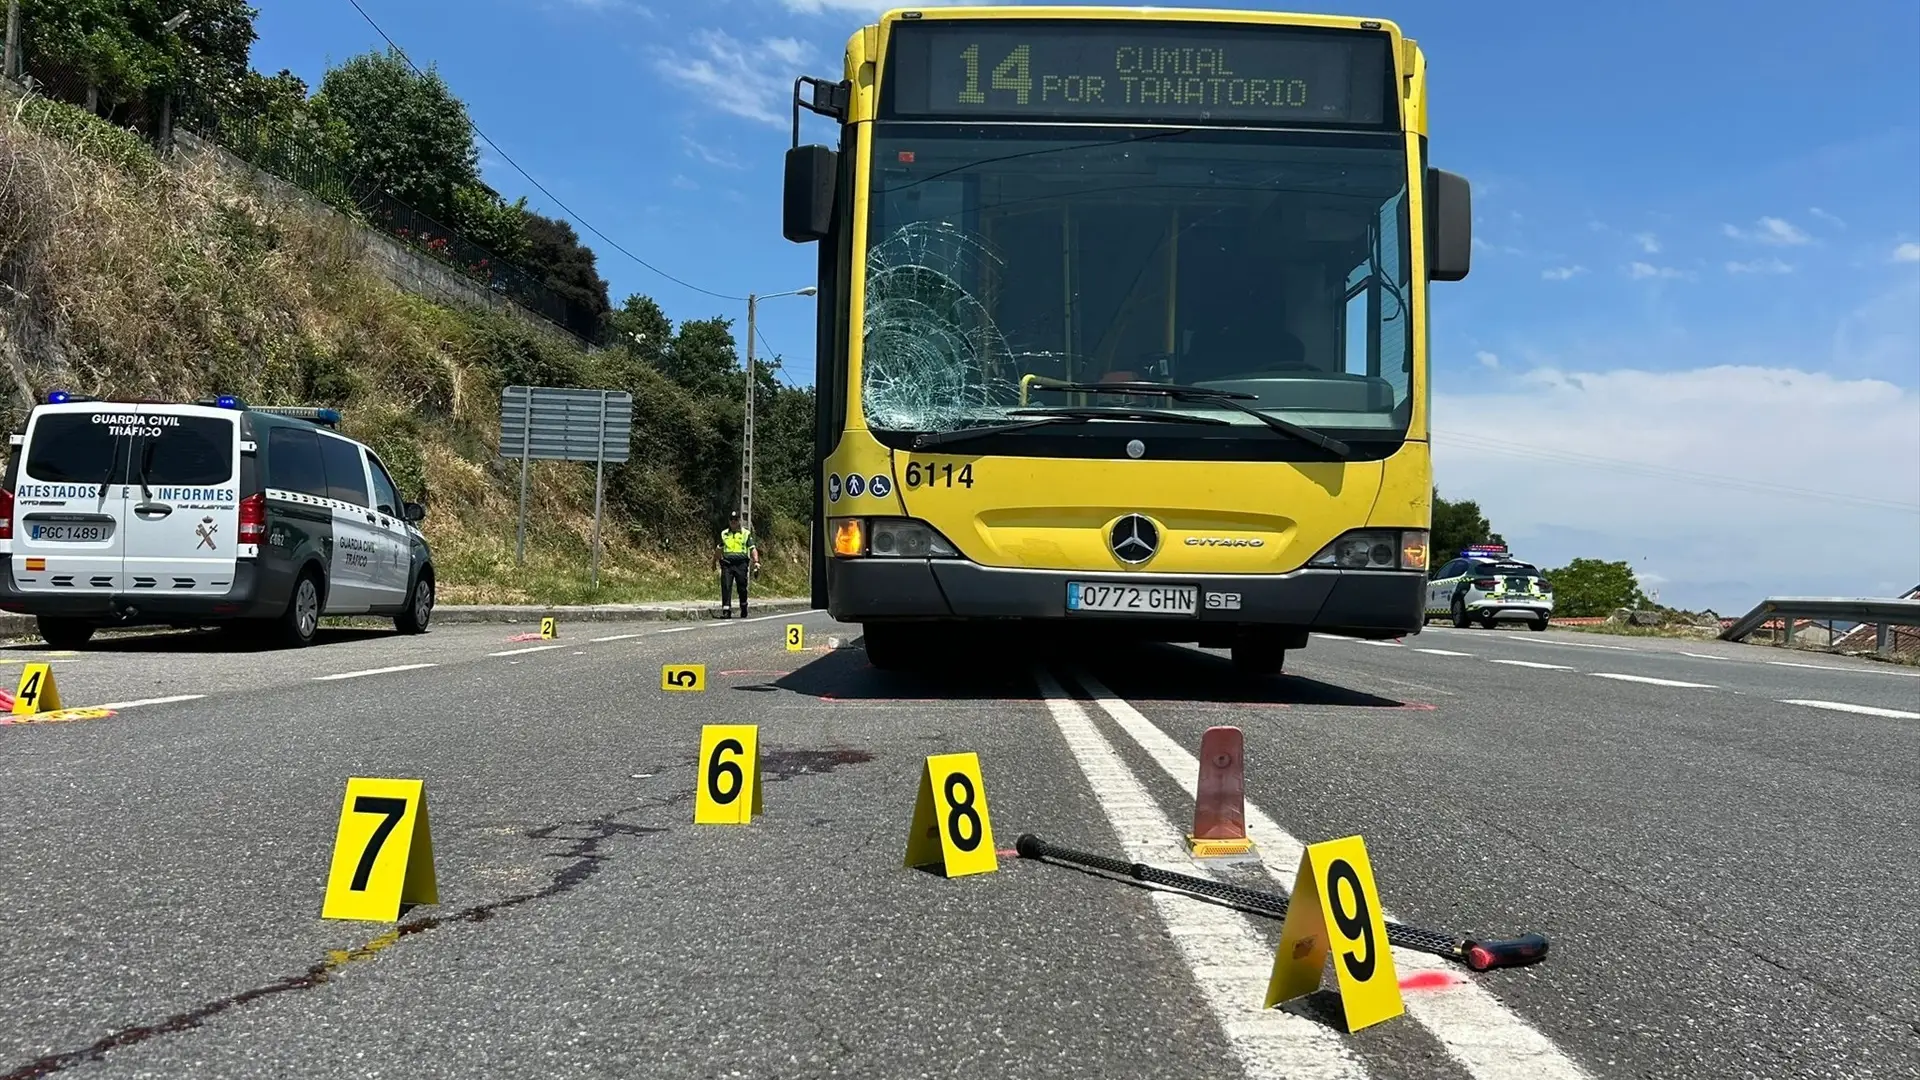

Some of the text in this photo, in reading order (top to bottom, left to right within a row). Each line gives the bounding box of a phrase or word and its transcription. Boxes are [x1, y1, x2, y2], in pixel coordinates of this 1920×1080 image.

[1116, 47, 1233, 75] CUMIAL
[959, 44, 1032, 104] 14
[1043, 75, 1306, 106] POR TANATORIO
[91, 414, 180, 427] GUARDIA CIVIL
[108, 424, 162, 437] TRÁFICO
[905, 461, 974, 489] 6114
[18, 485, 234, 501] ATESTADOS E INFORMES
[40, 526, 64, 539] PGC
[67, 527, 99, 539] 1489
[1184, 536, 1265, 548] CITARO
[339, 536, 362, 551] GUARDIA
[1083, 586, 1192, 610] 0772 GHN
[1208, 594, 1238, 608] SP
[542, 620, 552, 635] 2
[789, 627, 799, 646] 3
[20, 671, 41, 706] 4
[667, 670, 697, 687] 5
[707, 738, 744, 805] 6
[944, 772, 983, 852] 8
[349, 796, 407, 892] 7
[1327, 858, 1376, 982] 9
